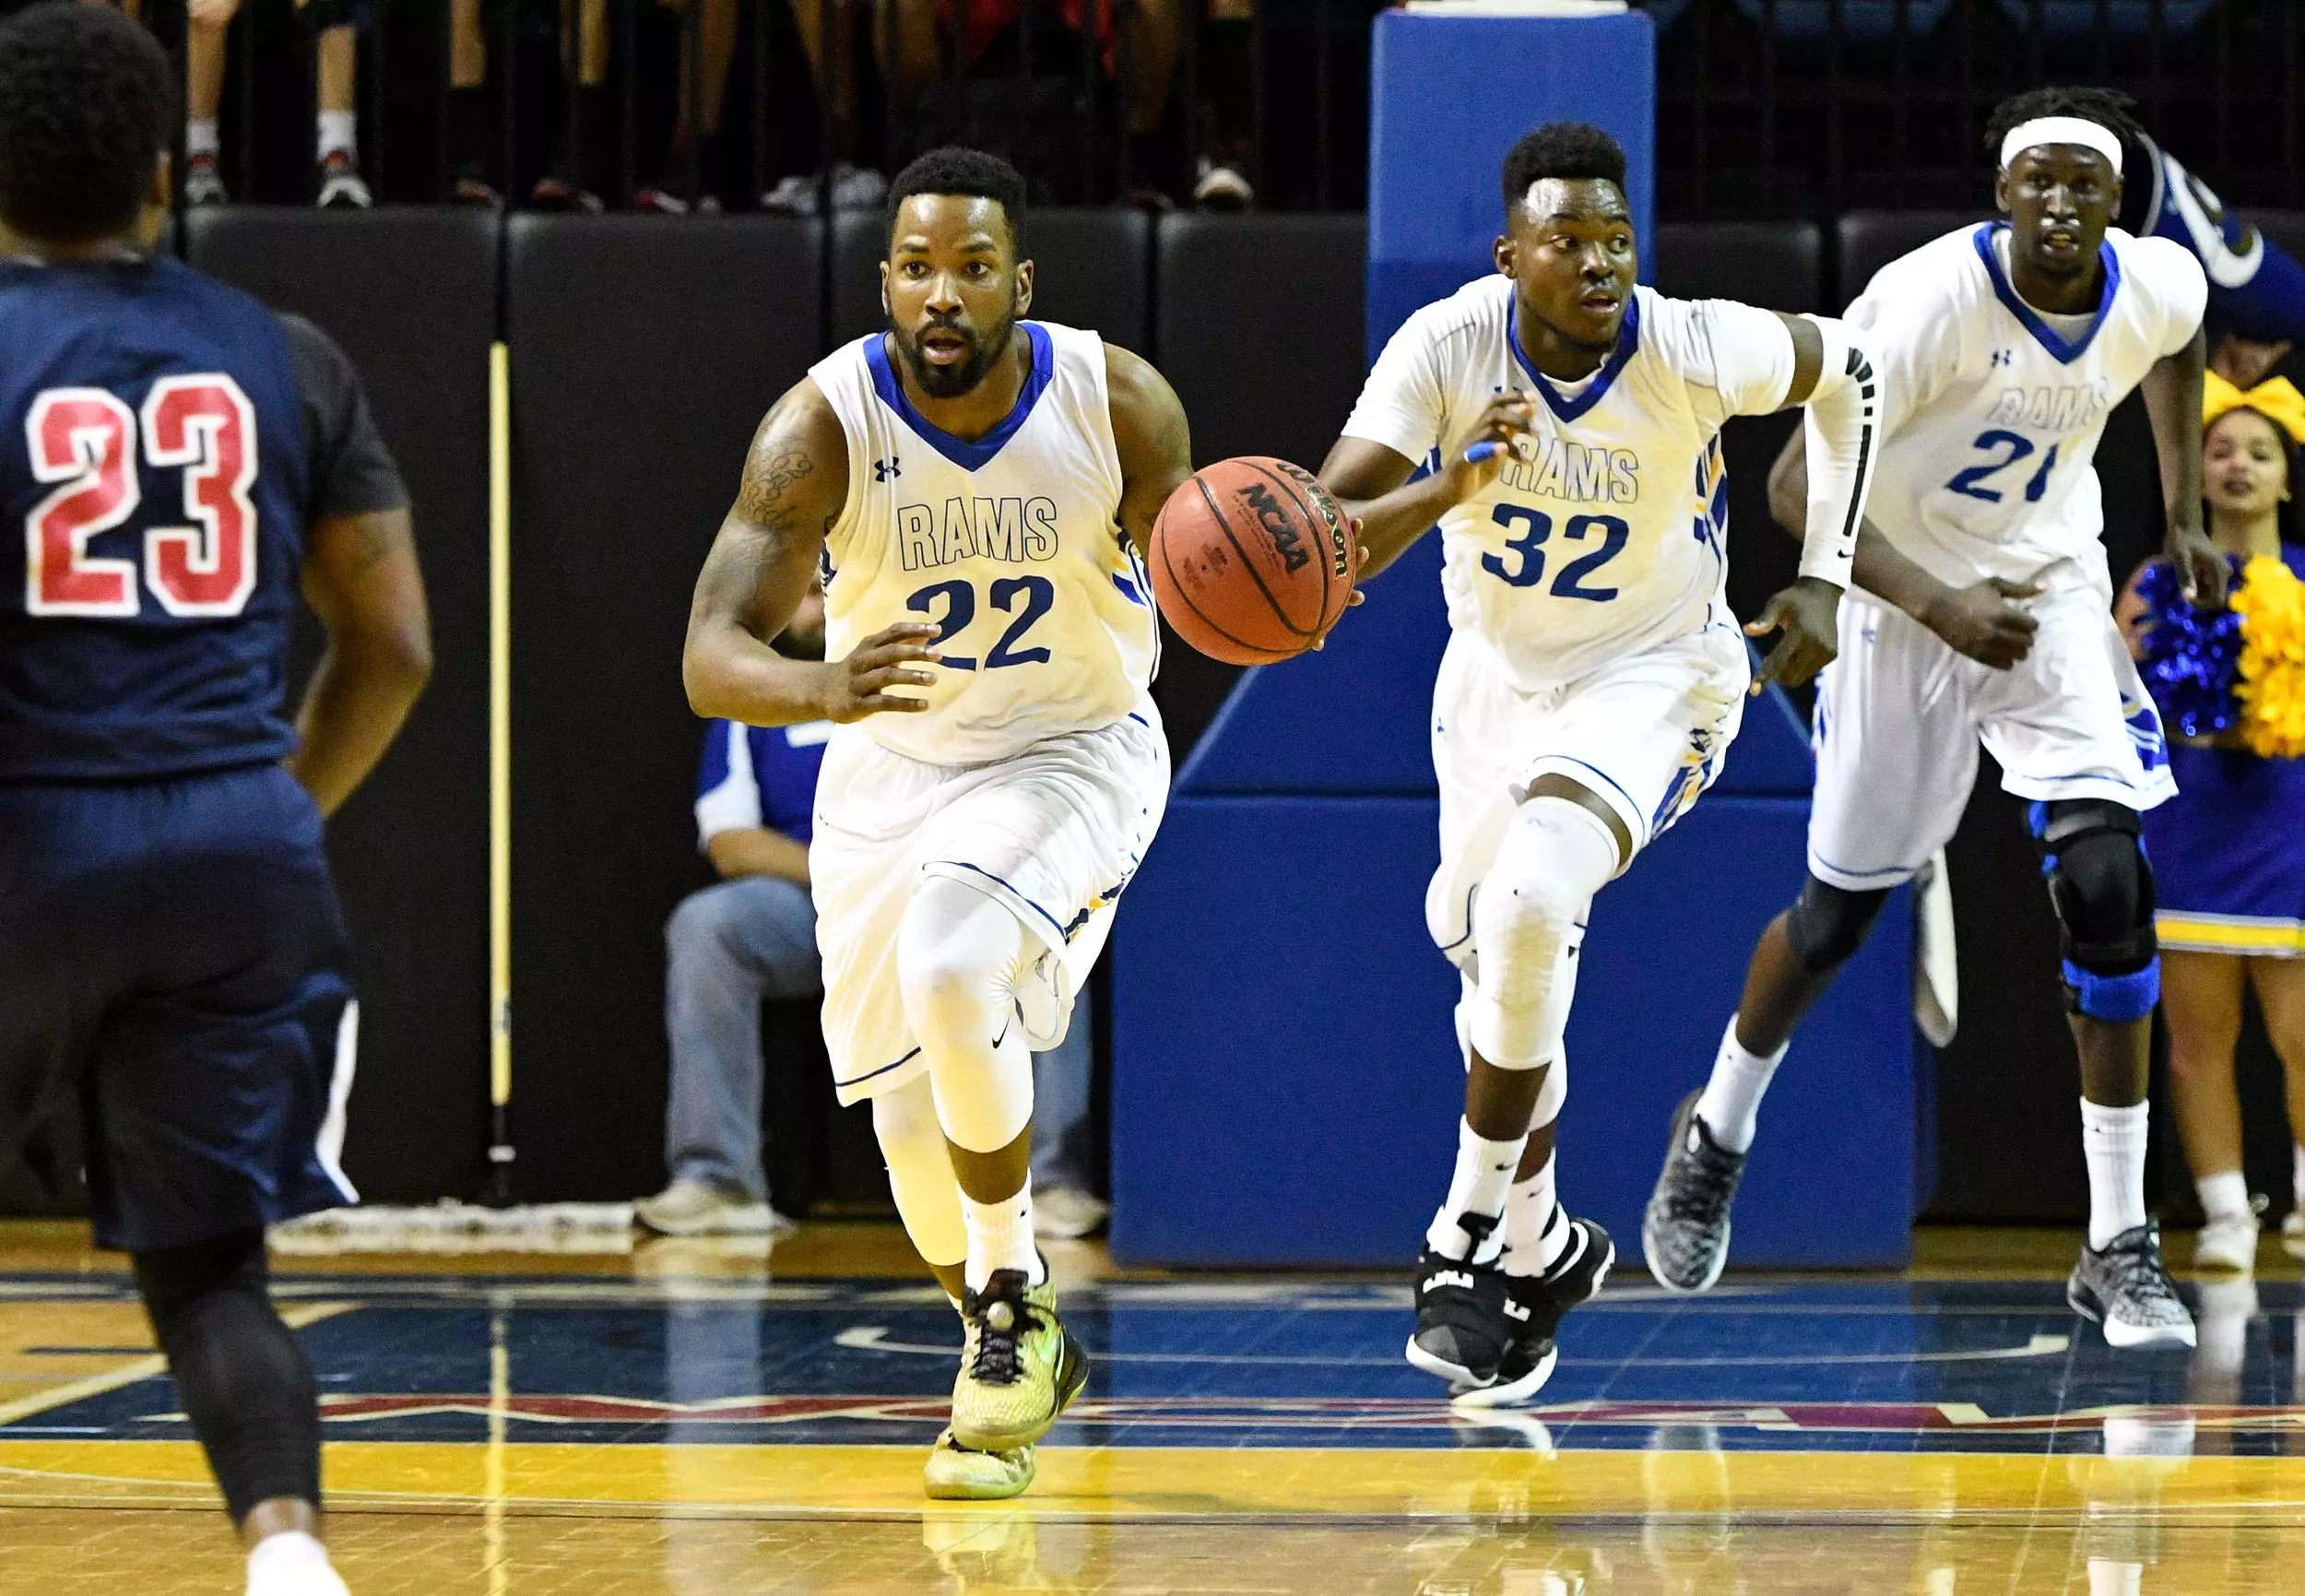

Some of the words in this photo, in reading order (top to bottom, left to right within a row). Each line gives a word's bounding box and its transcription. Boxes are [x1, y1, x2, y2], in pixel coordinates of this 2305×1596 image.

[25, 372, 258, 617] 23
[1499, 432, 1639, 504] RAMS
[1944, 430, 2059, 502] 21
[897, 496, 1058, 573] RAMS
[1236, 481, 1310, 573] NCAA
[1482, 502, 1630, 602] 32
[905, 575, 1056, 672] 22
